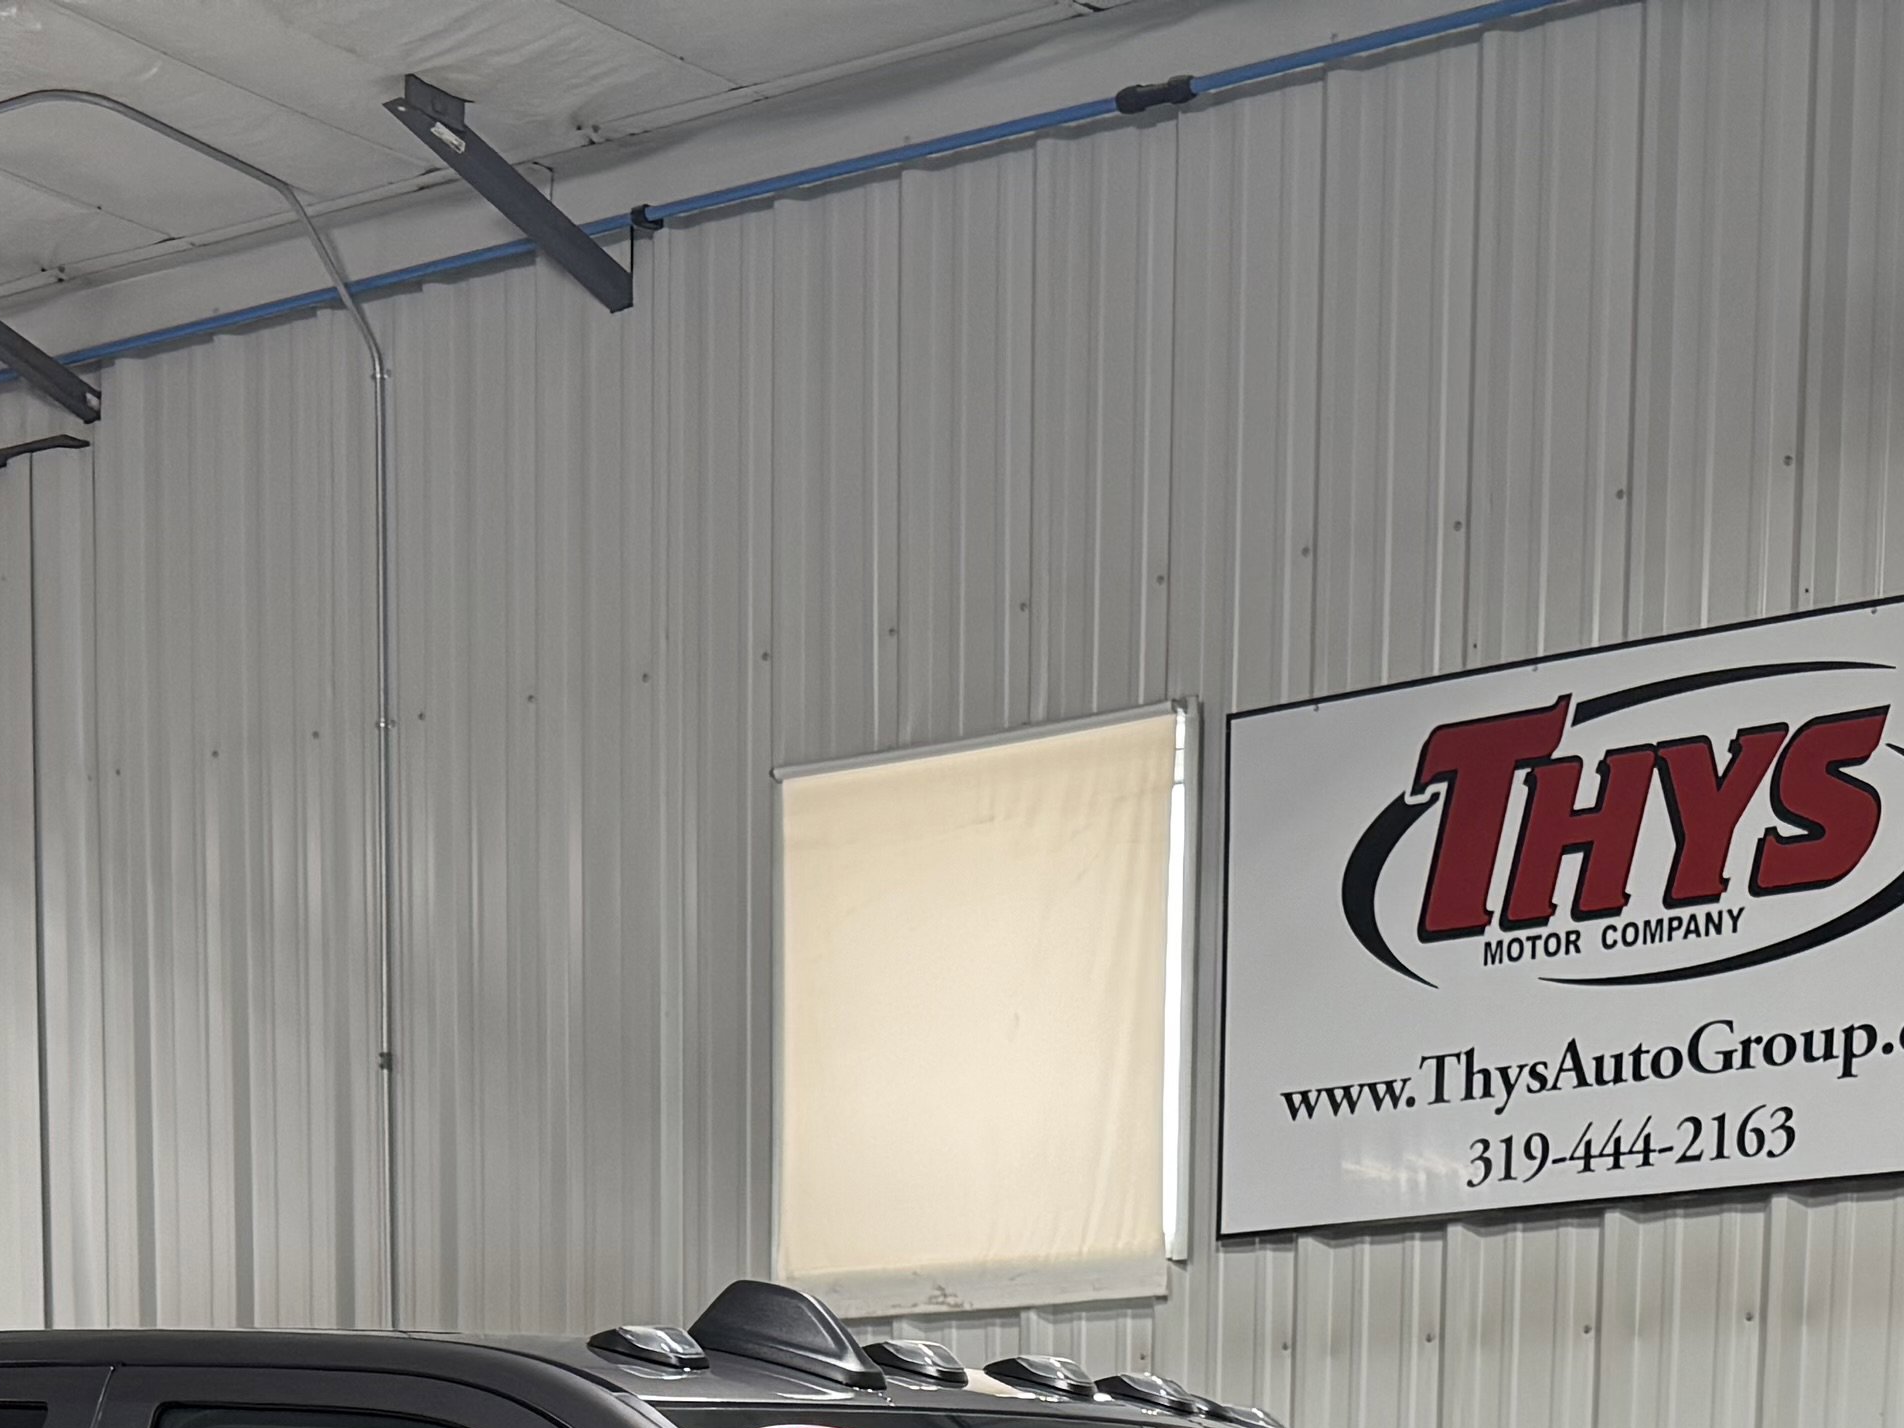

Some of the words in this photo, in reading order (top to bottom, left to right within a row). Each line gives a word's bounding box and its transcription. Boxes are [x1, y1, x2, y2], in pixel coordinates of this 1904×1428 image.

[1410, 692, 1892, 944] THYS
[1482, 930, 1582, 967] MOTOR
[1600, 907, 1747, 951] COMPANY
[1466, 1104, 1796, 1188] 319-444-2163
